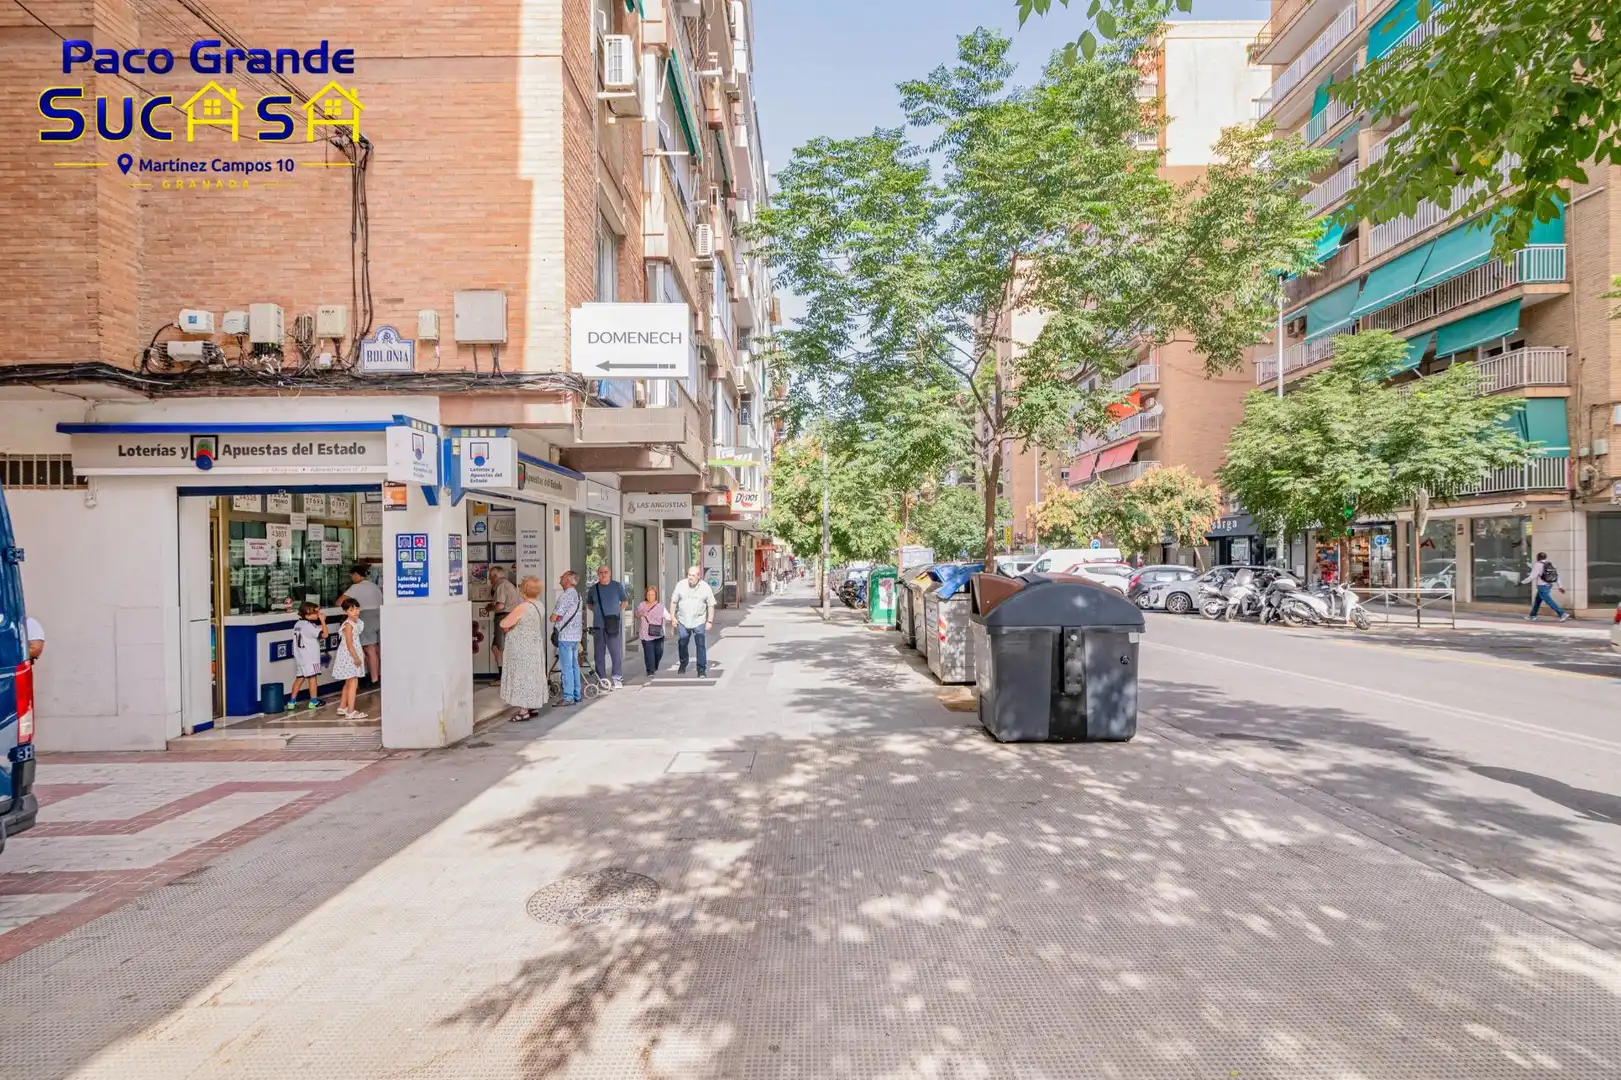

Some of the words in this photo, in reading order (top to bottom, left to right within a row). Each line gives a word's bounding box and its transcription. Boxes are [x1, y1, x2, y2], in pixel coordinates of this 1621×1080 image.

[588, 331, 682, 344] DOMENECH
[366, 350, 409, 362] BOLONIA
[118, 443, 177, 457] Loterías
[180, 446, 189, 459] y
[222, 443, 288, 459] Apuestas
[292, 443, 313, 455] del
[317, 442, 366, 455] Estado
